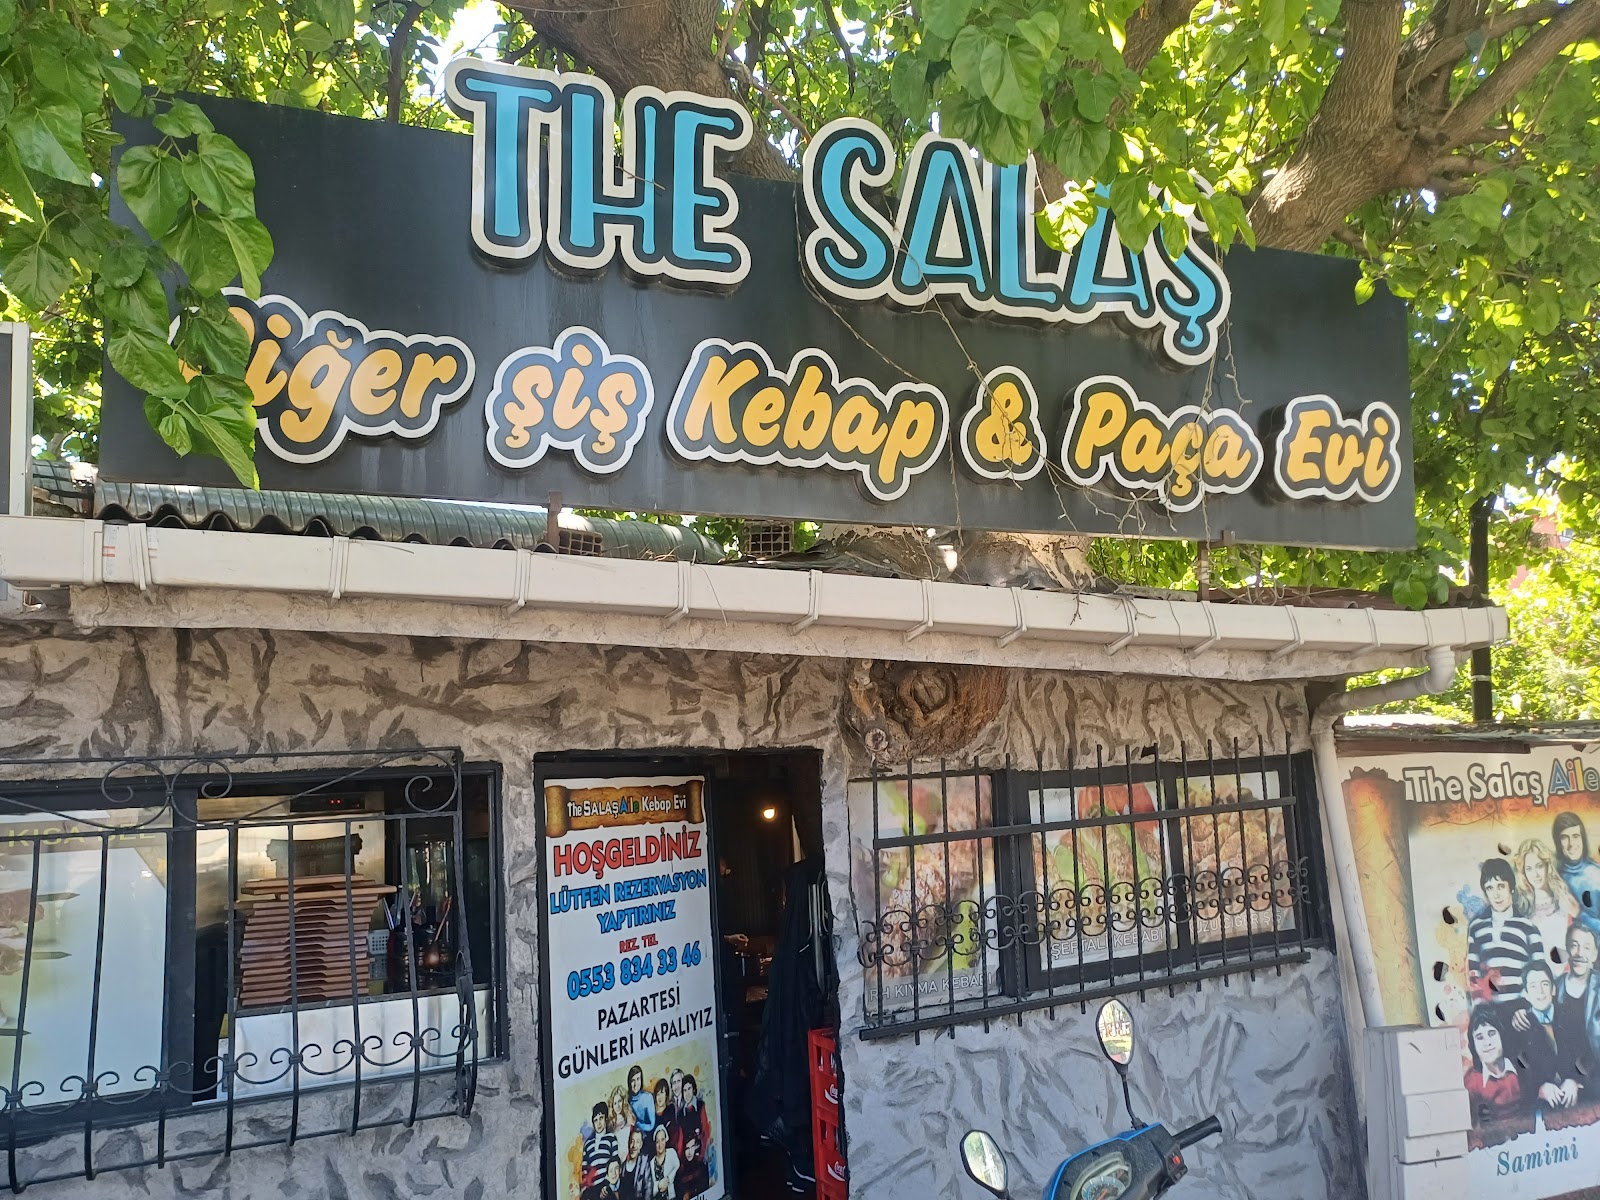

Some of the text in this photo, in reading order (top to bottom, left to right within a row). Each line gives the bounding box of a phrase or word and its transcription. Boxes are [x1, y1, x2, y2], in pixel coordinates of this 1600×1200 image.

[461, 72, 1220, 353] THE SALAŞ
[177, 302, 461, 446] iğer
[678, 350, 939, 488] Kebap
[970, 377, 1037, 468] &
[1070, 387, 1255, 500] Paça
[1282, 405, 1393, 491] Evi
[566, 801, 583, 818] The
[583, 799, 620, 819] SALAŞ
[641, 795, 672, 814] Kebap
[673, 794, 688, 810] Evi
[1466, 761, 1545, 807] Salaş
[553, 824, 702, 879] HOŞGELDİNİZ
[550, 868, 708, 914] LÜTFEN REZERVASYON
[597, 899, 677, 934] YAPTIRINIZ
[1113, 928, 1165, 948] KEBABI
[567, 940, 702, 1001] 0553 834 33 46
[894, 979, 939, 998] KIYMA
[597, 980, 681, 1031] PAZARTESİ
[558, 1006, 714, 1079] GÜNLERİ KAPALIYIZ
[1496, 1136, 1580, 1177] Samimi
